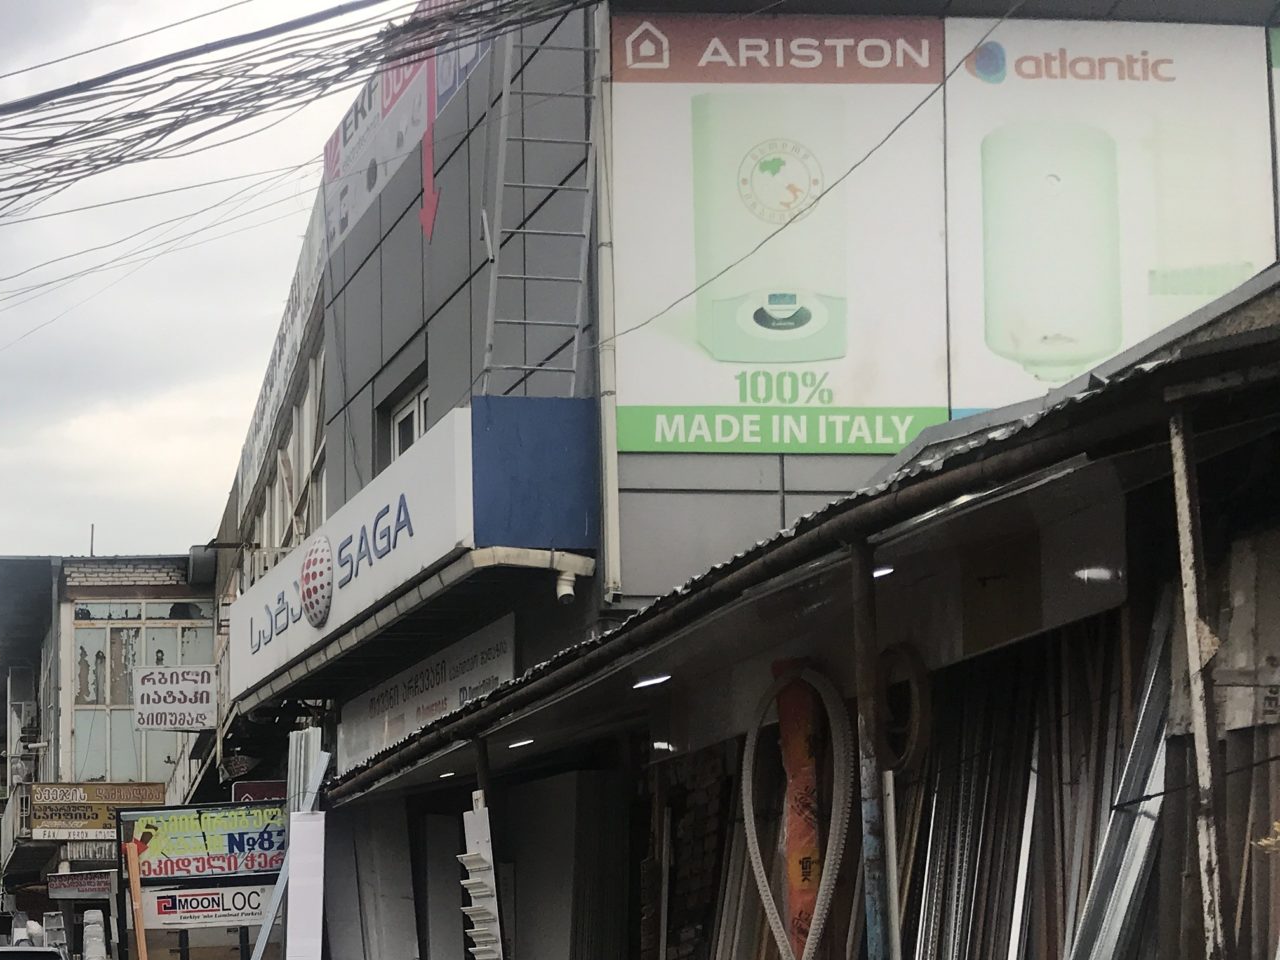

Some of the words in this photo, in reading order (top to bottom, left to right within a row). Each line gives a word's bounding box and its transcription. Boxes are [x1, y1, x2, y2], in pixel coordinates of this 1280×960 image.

[697, 36, 931, 70] ARISTON
[1014, 46, 1176, 83] atlantic
[733, 370, 835, 406] 100%
[654, 413, 762, 445] MADE
[770, 414, 806, 445] IN
[817, 414, 915, 446] ITALY
[336, 492, 415, 590] SAGA
[140, 669, 212, 687] რბილი
[139, 690, 211, 706] იატაკი
[137, 711, 209, 727] ბითუმად
[140, 853, 238, 877] ეკიდული
